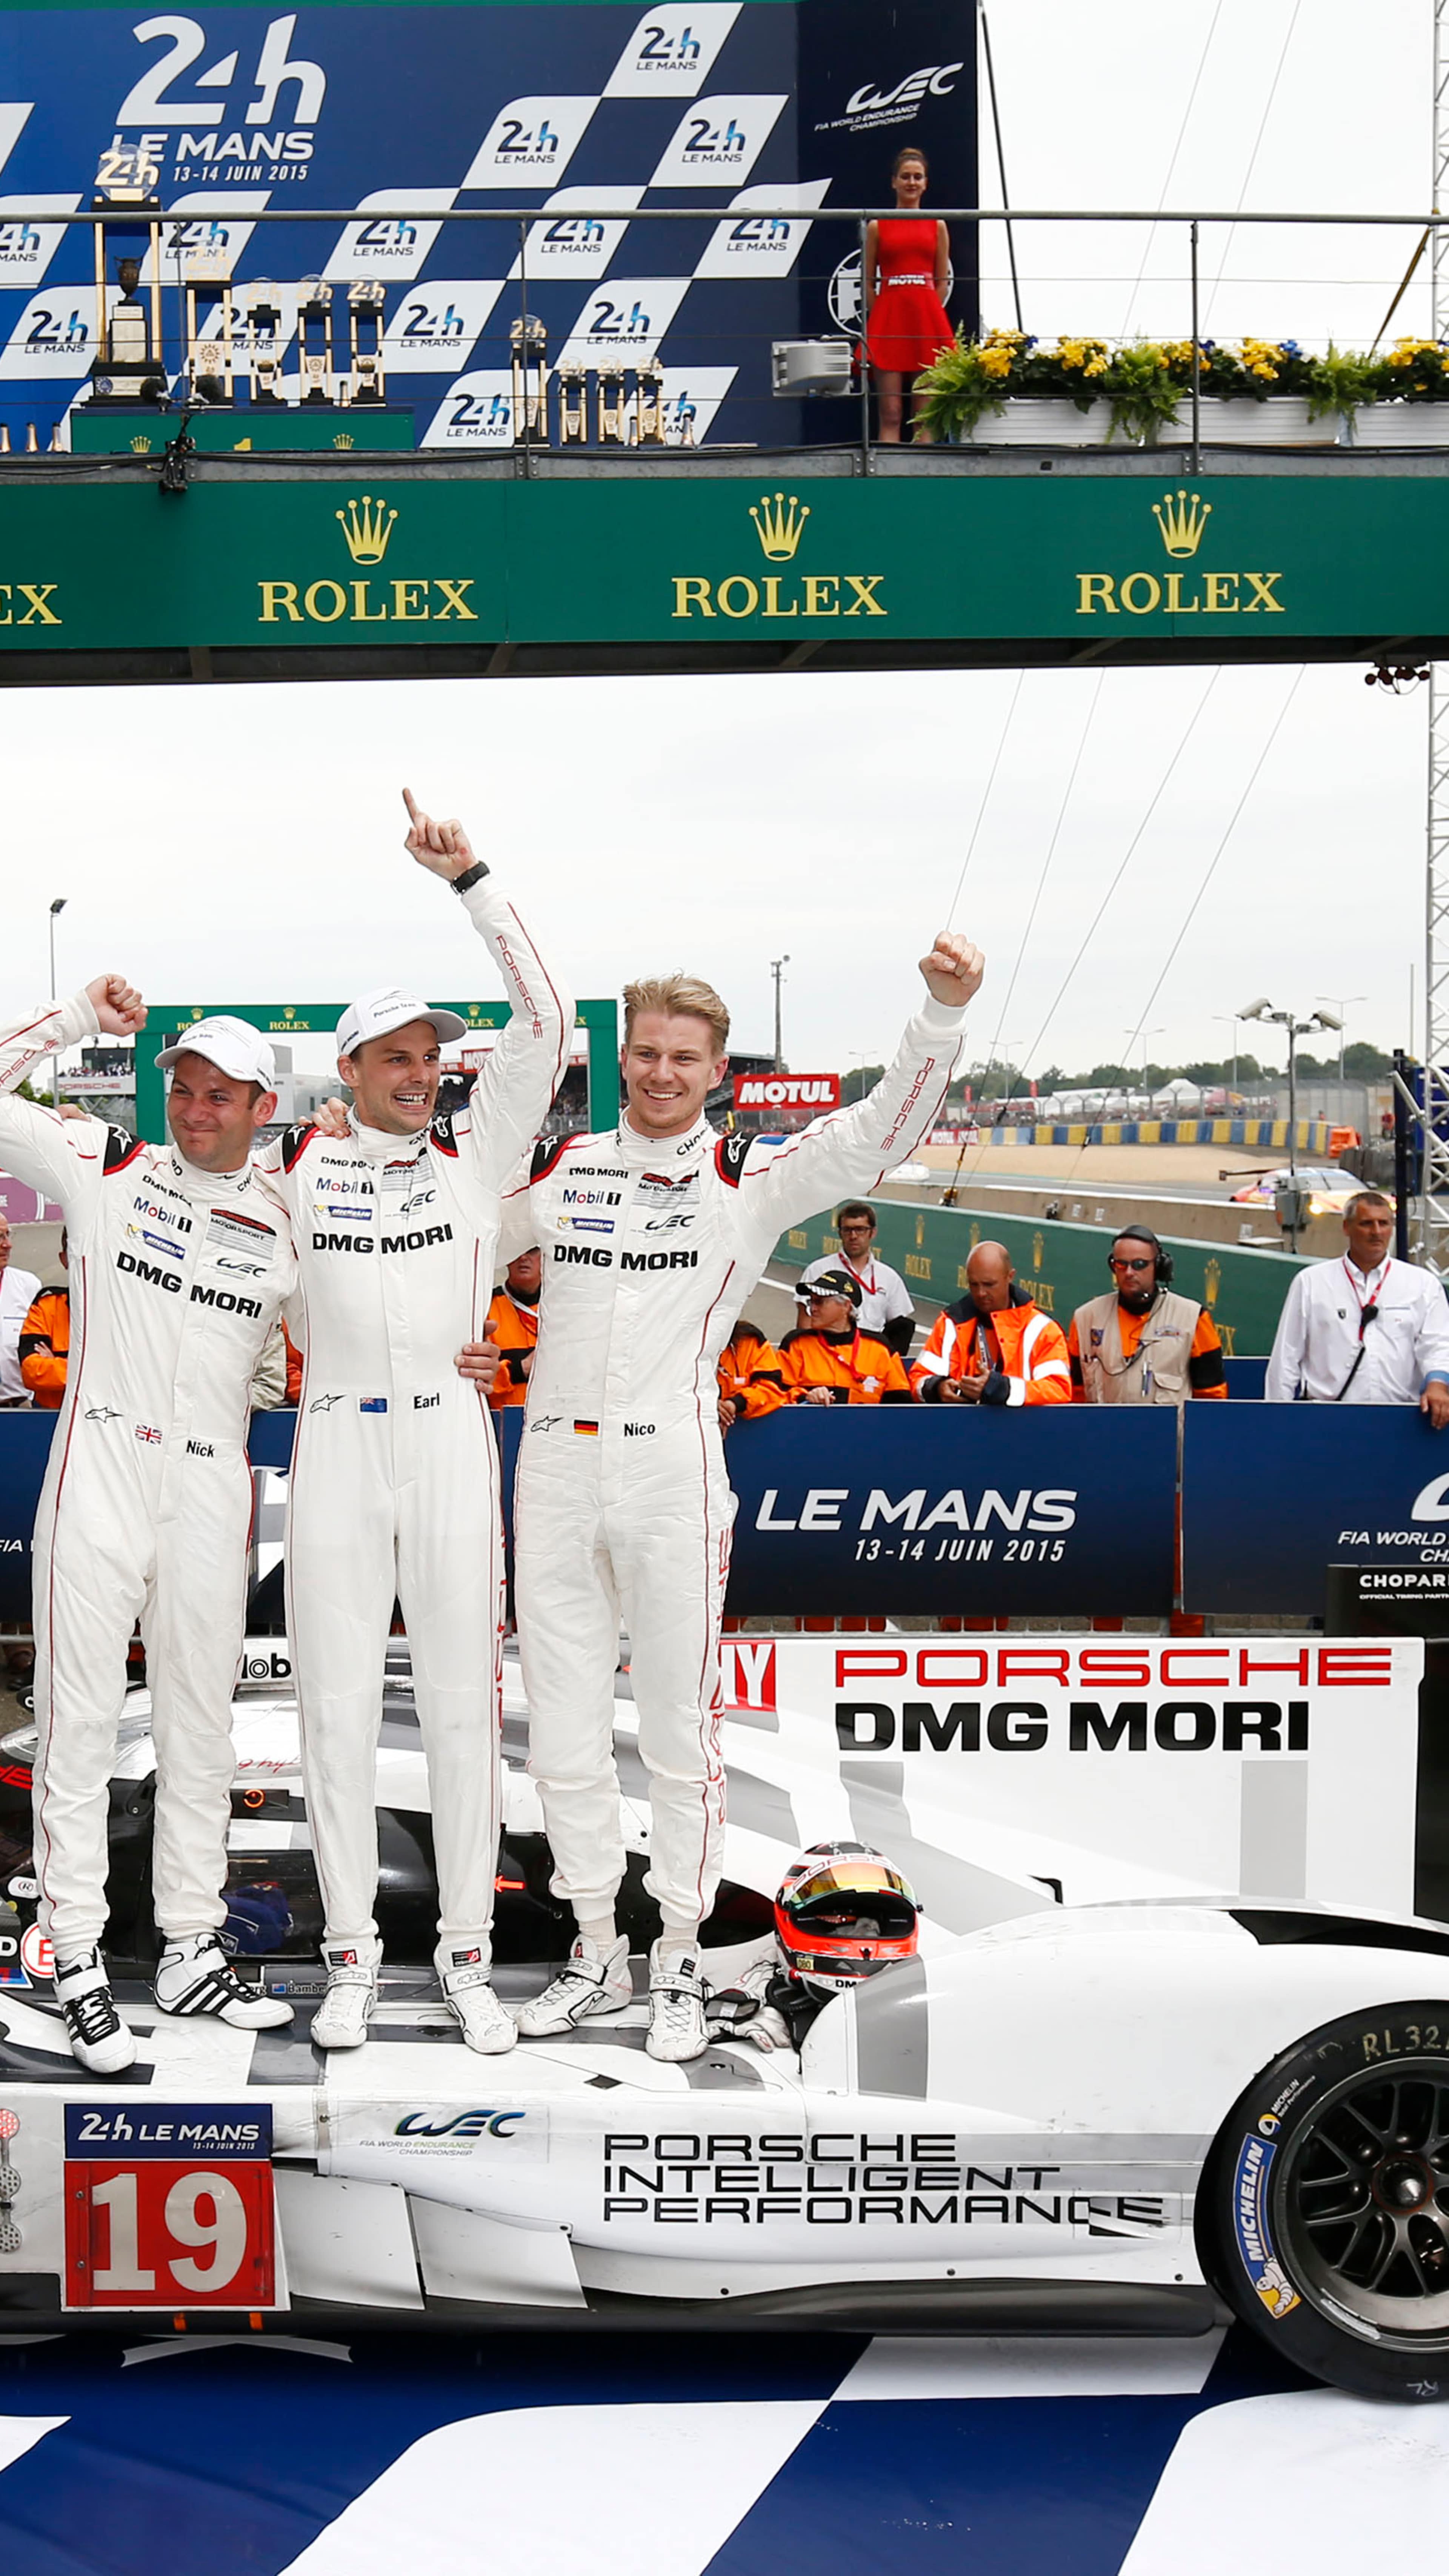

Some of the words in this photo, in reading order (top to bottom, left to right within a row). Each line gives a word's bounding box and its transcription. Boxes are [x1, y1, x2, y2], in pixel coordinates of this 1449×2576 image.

[639, 26, 700, 58] 24h
[116, 14, 327, 126] 24h
[637, 62, 653, 71] LE
[657, 61, 697, 71] MANS
[846, 62, 964, 114] WEC
[831, 116, 862, 128] WORLD
[862, 103, 920, 122] ENDURANCE
[849, 113, 917, 132] CHAMPIONSHIP
[109, 134, 168, 162] LE
[176, 132, 314, 161] MANS
[497, 120, 558, 152] 24h
[684, 119, 746, 152] 24h
[94, 152, 159, 186] 24h
[494, 155, 511, 164] LE
[515, 154, 555, 164] MANS
[681, 154, 698, 162] LE
[702, 153, 742, 163] MANS
[173, 166, 219, 181] 13-14
[225, 166, 262, 181] JUIN
[268, 165, 308, 180] 2015
[355, 220, 417, 245] 24h
[544, 220, 605, 241] 24h
[730, 214, 790, 240] 24h
[353, 248, 369, 256] LE
[373, 247, 414, 255] MANS
[541, 244, 558, 253] LE
[561, 243, 601, 252] MANS
[727, 243, 743, 251] LE
[747, 242, 787, 251] MANS
[28, 309, 88, 344] 24h
[403, 304, 464, 335] 24h
[590, 301, 650, 333] 24h
[24, 344, 42, 354] LE
[45, 344, 85, 353] MANS
[420, 338, 461, 347] MANS
[605, 335, 646, 344] MANS
[449, 393, 509, 424] 24h
[447, 428, 461, 437] LE
[465, 427, 507, 436] MANS
[258, 580, 478, 622] ROLEX
[671, 575, 888, 618] ROLEX
[1075, 572, 1285, 615] ROLEX
[495, 935, 544, 1039] PORSCHE
[269, 1021, 310, 1030] ROLEX
[738, 1080, 834, 1103] MOTUL
[881, 1057, 935, 1151] PORSCHE
[321, 1156, 348, 1167] DMG
[597, 1168, 629, 1179] MORI
[316, 1178, 358, 1194] Mobil
[563, 1189, 604, 1205] Mobil
[606, 1192, 622, 1206] 1
[134, 1196, 176, 1226] Mobil
[178, 1216, 192, 1233] 1
[574, 1218, 614, 1231] MICHELIN
[645, 1214, 696, 1230] WEC
[312, 1232, 374, 1253] DMG
[381, 1223, 453, 1254] MORI
[217, 1257, 267, 1278] WEC
[554, 1244, 613, 1267] DMG
[621, 1250, 698, 1271] MORI
[905, 1254, 932, 1280] ROLEX
[117, 1251, 183, 1293] DMG
[190, 1284, 263, 1319] MORI
[414, 1392, 440, 1409] Earl
[624, 1423, 655, 1436] Nico
[186, 1440, 215, 1458] Nick
[755, 1489, 848, 1531] LE
[860, 1489, 1077, 1531] MANS
[854, 1540, 923, 1561] 13-14
[935, 1540, 992, 1561] JUIN
[1003, 1540, 1066, 1561] 2015
[1338, 1531, 1370, 1545] FIA
[1377, 1532, 1446, 1546] WORLD
[1359, 1575, 1449, 1587] CHOPAR
[835, 1649, 1392, 1687] PORSCHE
[835, 1702, 1049, 1752] DMG
[1069, 1701, 1309, 1752] MORI
[288, 1983, 325, 1995] Bambe
[1271, 2079, 1300, 2114] MICHELIN
[78, 2112, 134, 2141] 24h
[138, 2124, 175, 2141] LE
[178, 2124, 260, 2141] MANS
[395, 2109, 526, 2138] WEC
[604, 2133, 956, 2162] PORSCHE
[604, 2166, 1060, 2193] INTELLIGENT
[604, 2196, 1164, 2225] PERFORMANCE
[1240, 2141, 1264, 2262] MICHELIN
[91, 2171, 248, 2293] 19
